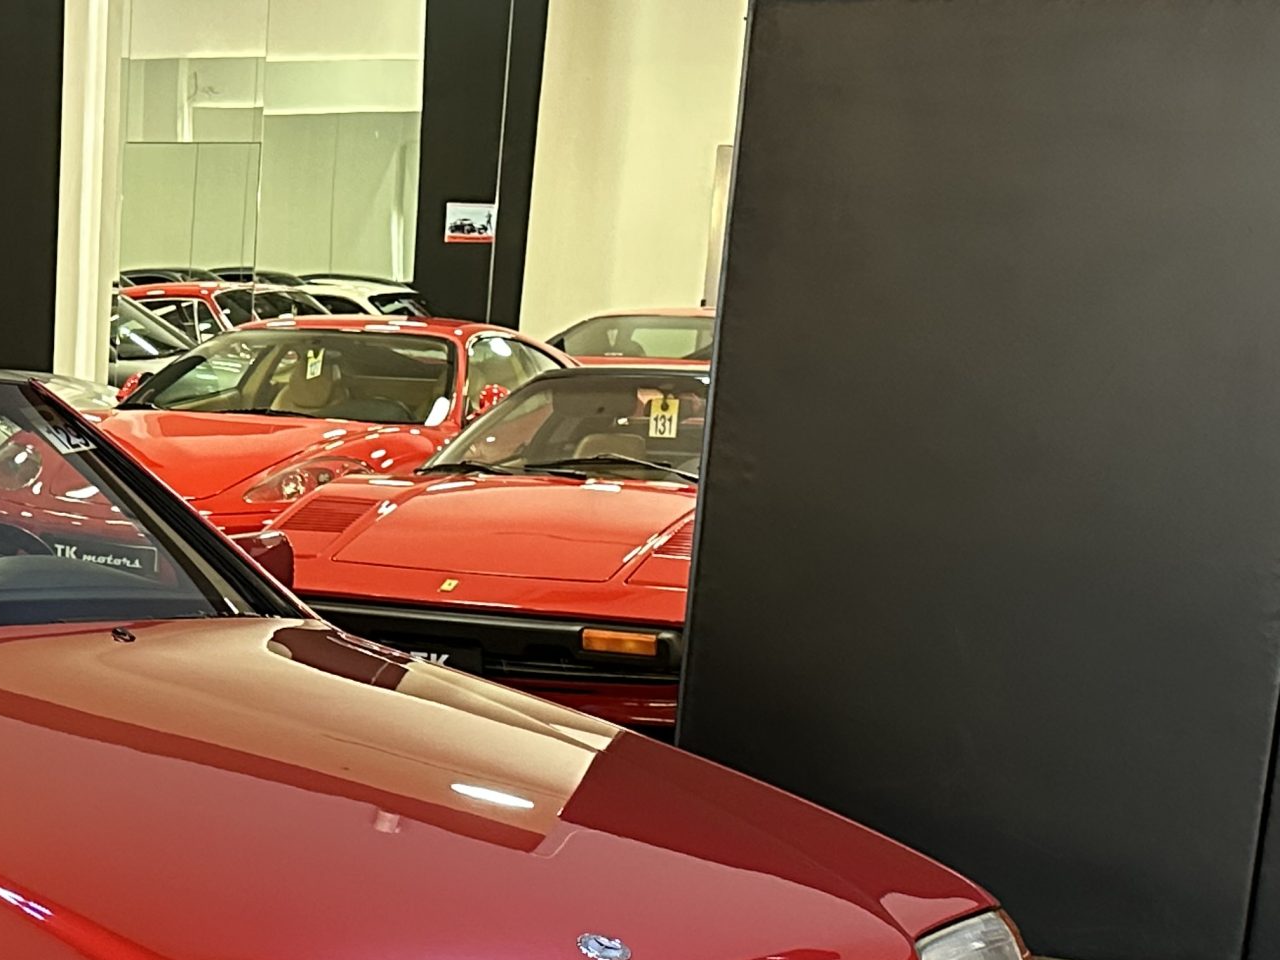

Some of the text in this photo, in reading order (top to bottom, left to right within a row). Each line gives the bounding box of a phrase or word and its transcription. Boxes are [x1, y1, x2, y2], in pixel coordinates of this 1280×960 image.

[46, 422, 90, 449] 129
[653, 414, 673, 435] 131
[54, 543, 142, 569] TK motors
